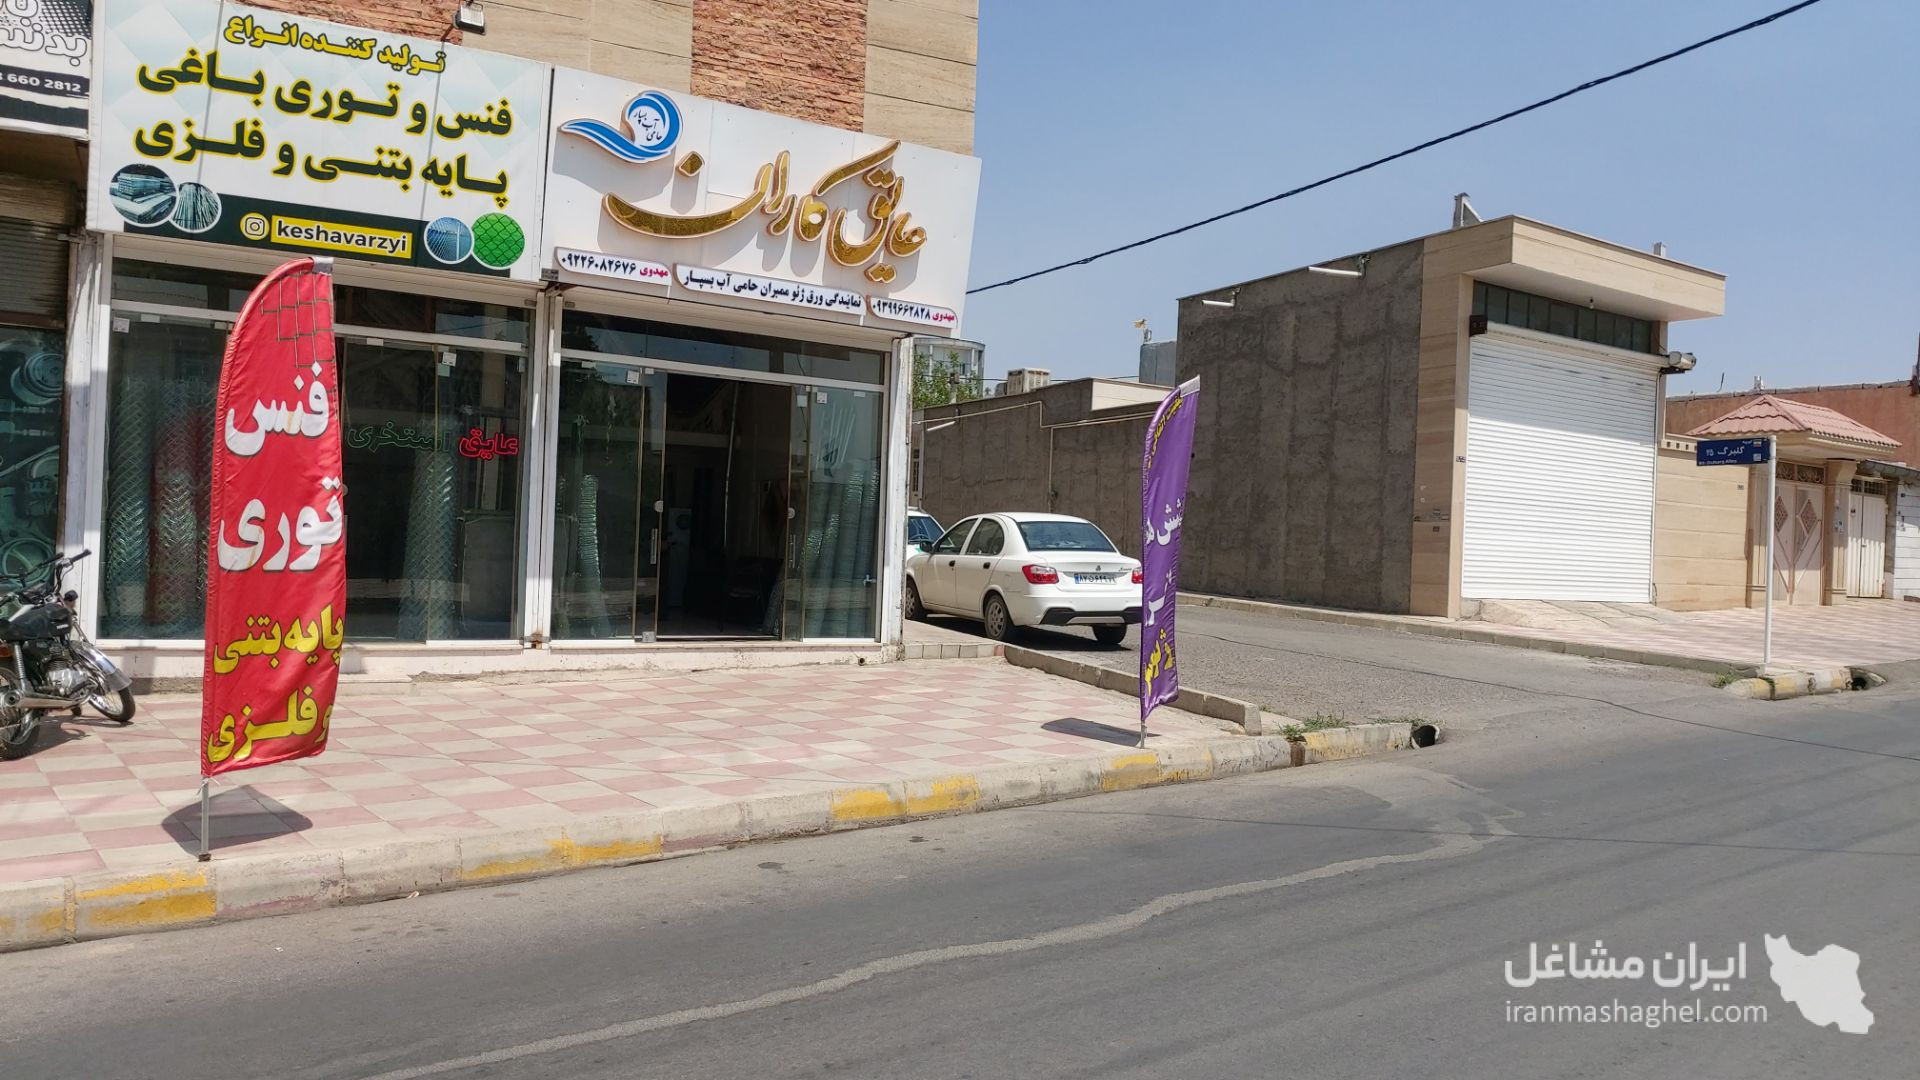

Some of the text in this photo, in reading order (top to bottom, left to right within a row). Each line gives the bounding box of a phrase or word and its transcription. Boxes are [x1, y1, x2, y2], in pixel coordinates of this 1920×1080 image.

[223, 15, 447, 75] تولید کننده انواع
[7, 73, 40, 87] 660
[44, 79, 81, 92] 2812
[137, 48, 513, 139] فنس و توری باغی
[134, 118, 508, 209] پایه بتنی و فلزی
[277, 219, 408, 254] keshavarzyi
[826, 167, 927, 284] عایق
[639, 266, 669, 279] مهدوی
[683, 270, 714, 290] بسپار
[716, 273, 731, 288] آب
[733, 278, 758, 293] حامی
[760, 281, 790, 298] ممبران
[806, 290, 823, 306] ورق
[825, 292, 862, 310] نمایندگی
[932, 312, 955, 322] مهدوی
[224, 361, 331, 457] فنس
[459, 428, 519, 460] عایق
[1717, 446, 1745, 457] گلبرگ
[217, 475, 342, 571] توری
[213, 604, 344, 675] پایه بتنی
[206, 685, 335, 764] و فلزی
